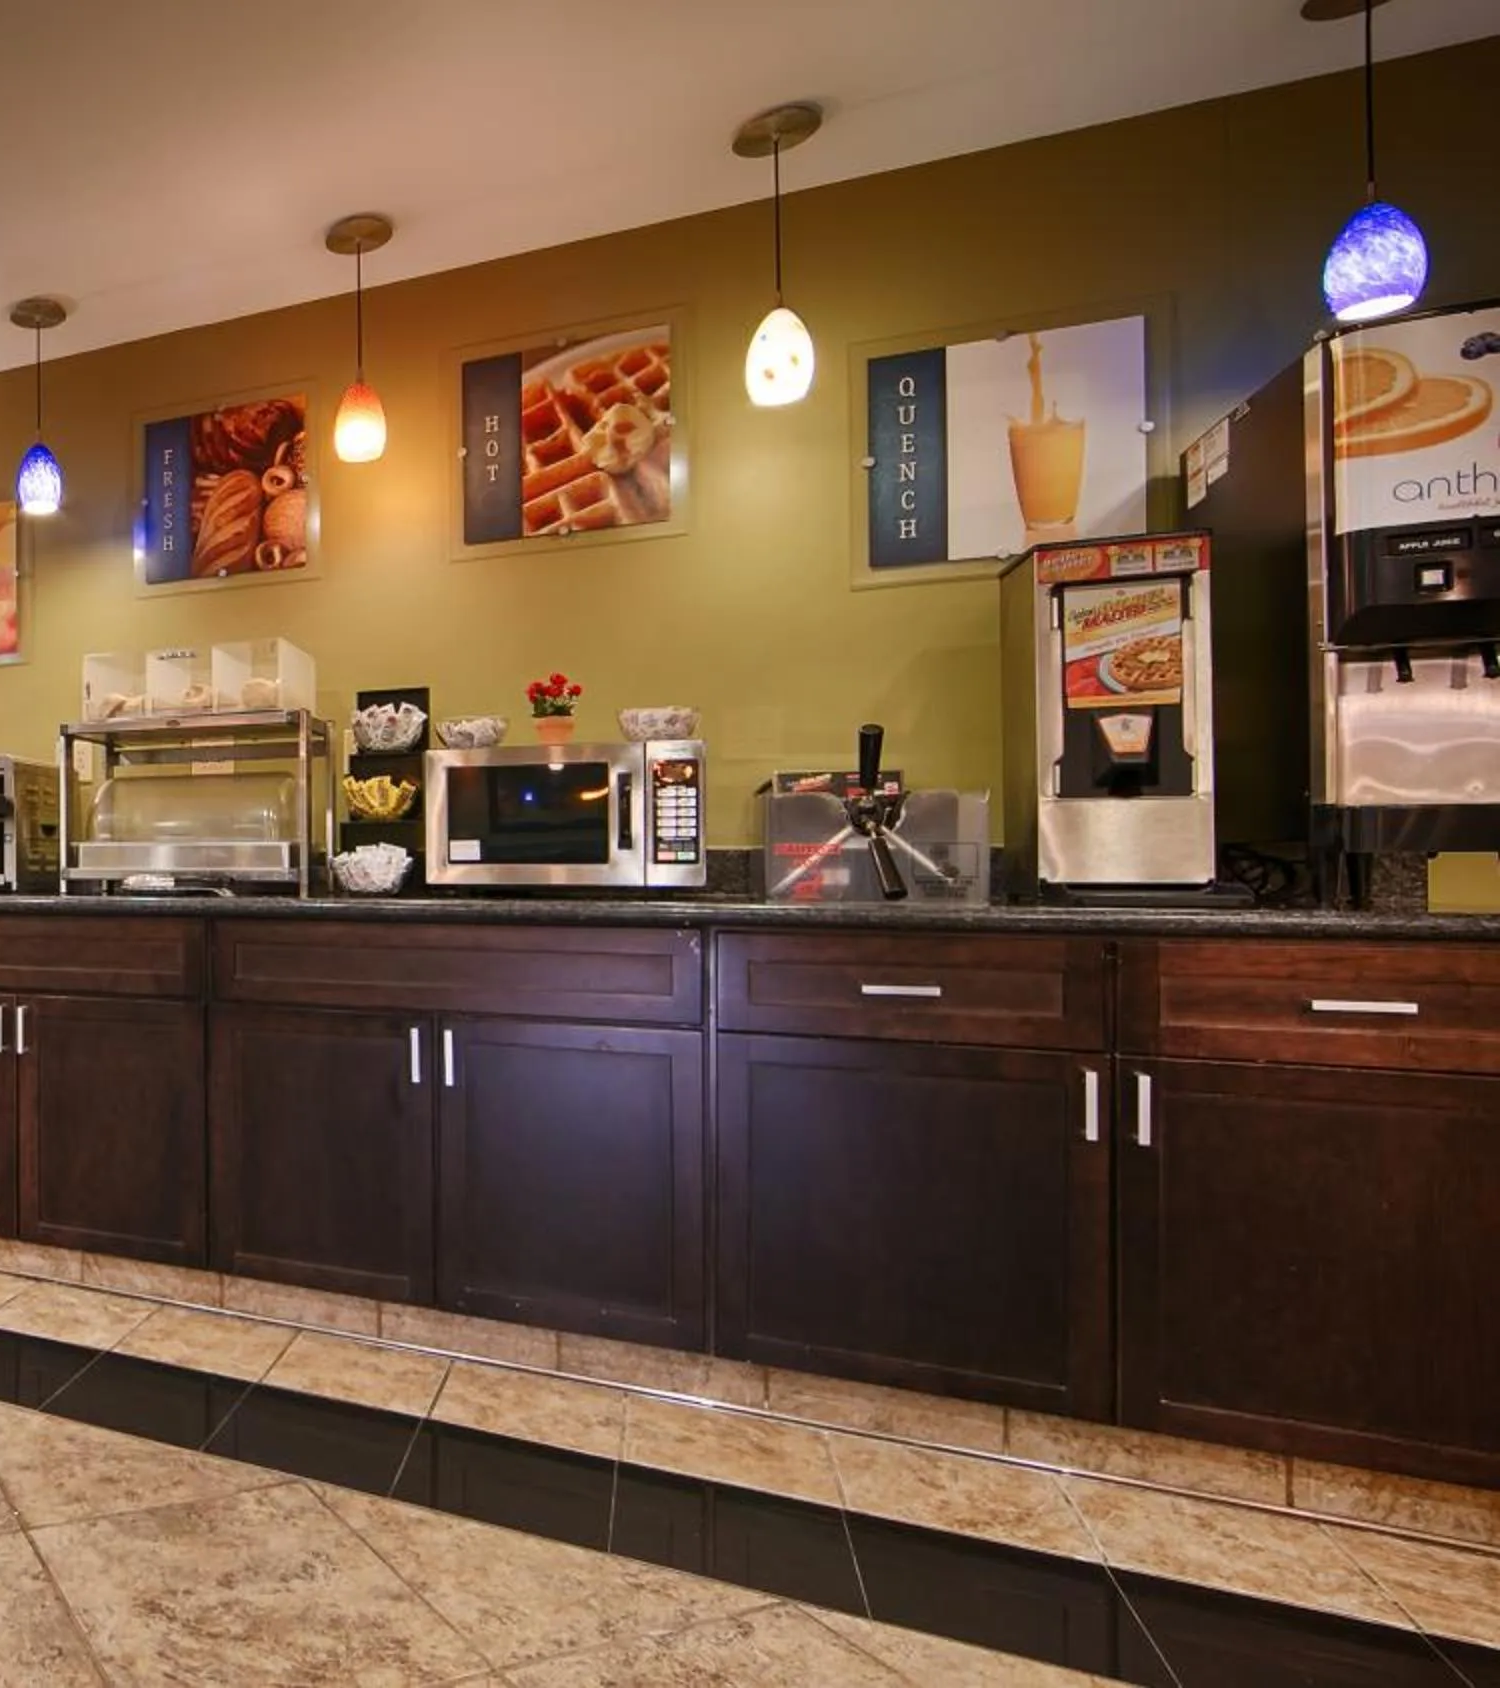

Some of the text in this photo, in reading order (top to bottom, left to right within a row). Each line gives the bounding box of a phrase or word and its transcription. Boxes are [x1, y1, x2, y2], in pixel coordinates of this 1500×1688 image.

[485, 415, 499, 481] HOT
[898, 376, 917, 538] QUENCH
[1393, 461, 1497, 502] anth
[163, 449, 173, 551] FRESH
